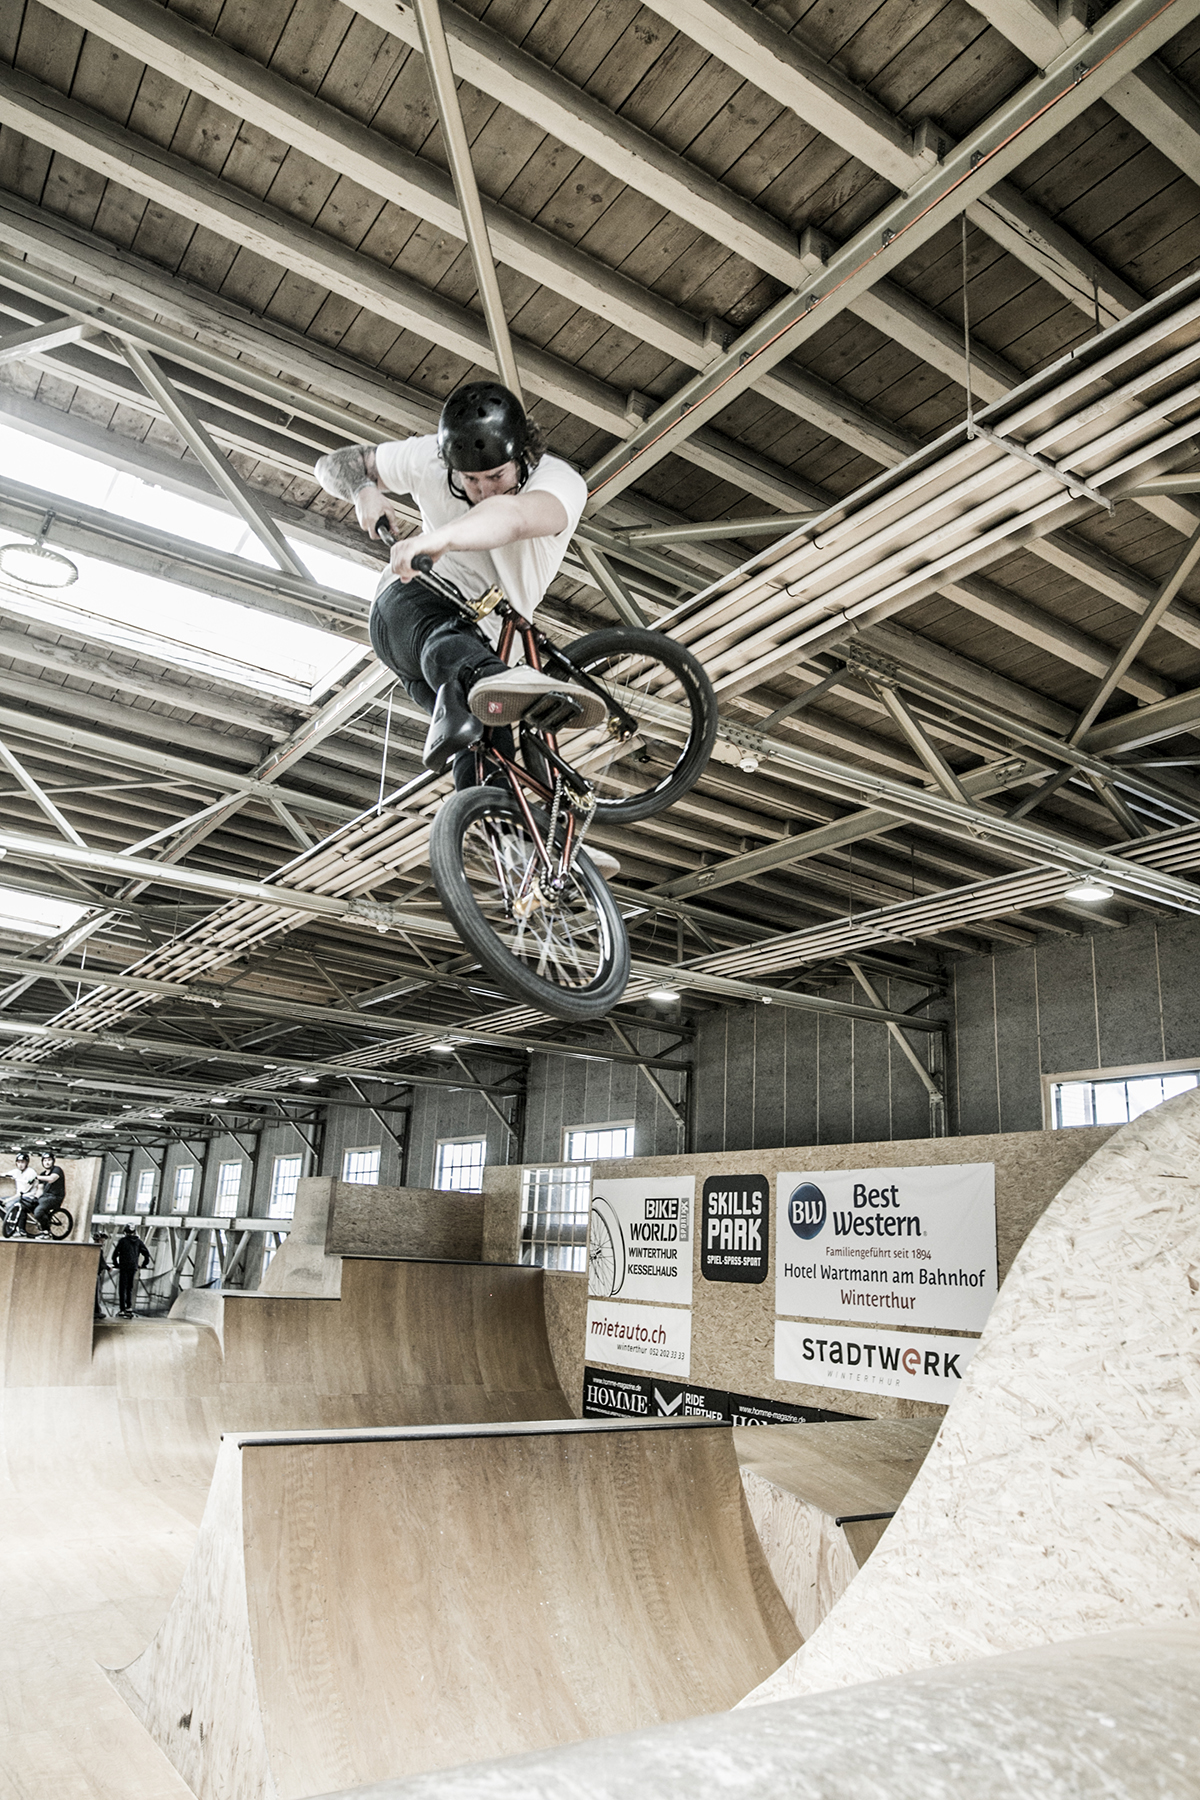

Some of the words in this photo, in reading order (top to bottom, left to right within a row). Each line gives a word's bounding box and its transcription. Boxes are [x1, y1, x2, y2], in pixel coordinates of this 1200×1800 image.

[708, 1191, 762, 1215] SKILLS
[854, 1184, 900, 1208] Best
[645, 1199, 678, 1219] BIKE
[792, 1200, 823, 1224] BW
[630, 1223, 678, 1241] WORLD
[833, 1211, 922, 1236] Western
[707, 1218, 762, 1251] PARK
[628, 1247, 678, 1259] WINTERTHUR
[826, 1247, 891, 1259] Familiengeführt
[893, 1249, 909, 1259] seit
[912, 1249, 932, 1260] 1894
[627, 1264, 678, 1277] KESSELHAUS
[784, 1263, 817, 1279] Hotel
[820, 1264, 888, 1283] Wartmann
[892, 1271, 914, 1284] am
[919, 1268, 986, 1287] Bahnhof
[840, 1289, 916, 1310] Winterthur
[591, 1317, 667, 1344] mietauto.ch
[617, 1343, 647, 1354] winterthur
[650, 1347, 658, 1356] 052
[660, 1349, 669, 1358] 202
[670, 1350, 677, 1359] 33
[678, 1351, 685, 1360] 33
[827, 1370, 901, 1387] WINTERTHUR
[586, 1384, 648, 1414] HOMME
[685, 1392, 705, 1407] RIDE
[684, 1405, 723, 1421] FURTHER
[739, 1405, 806, 1424] www.homme-magazine.de
